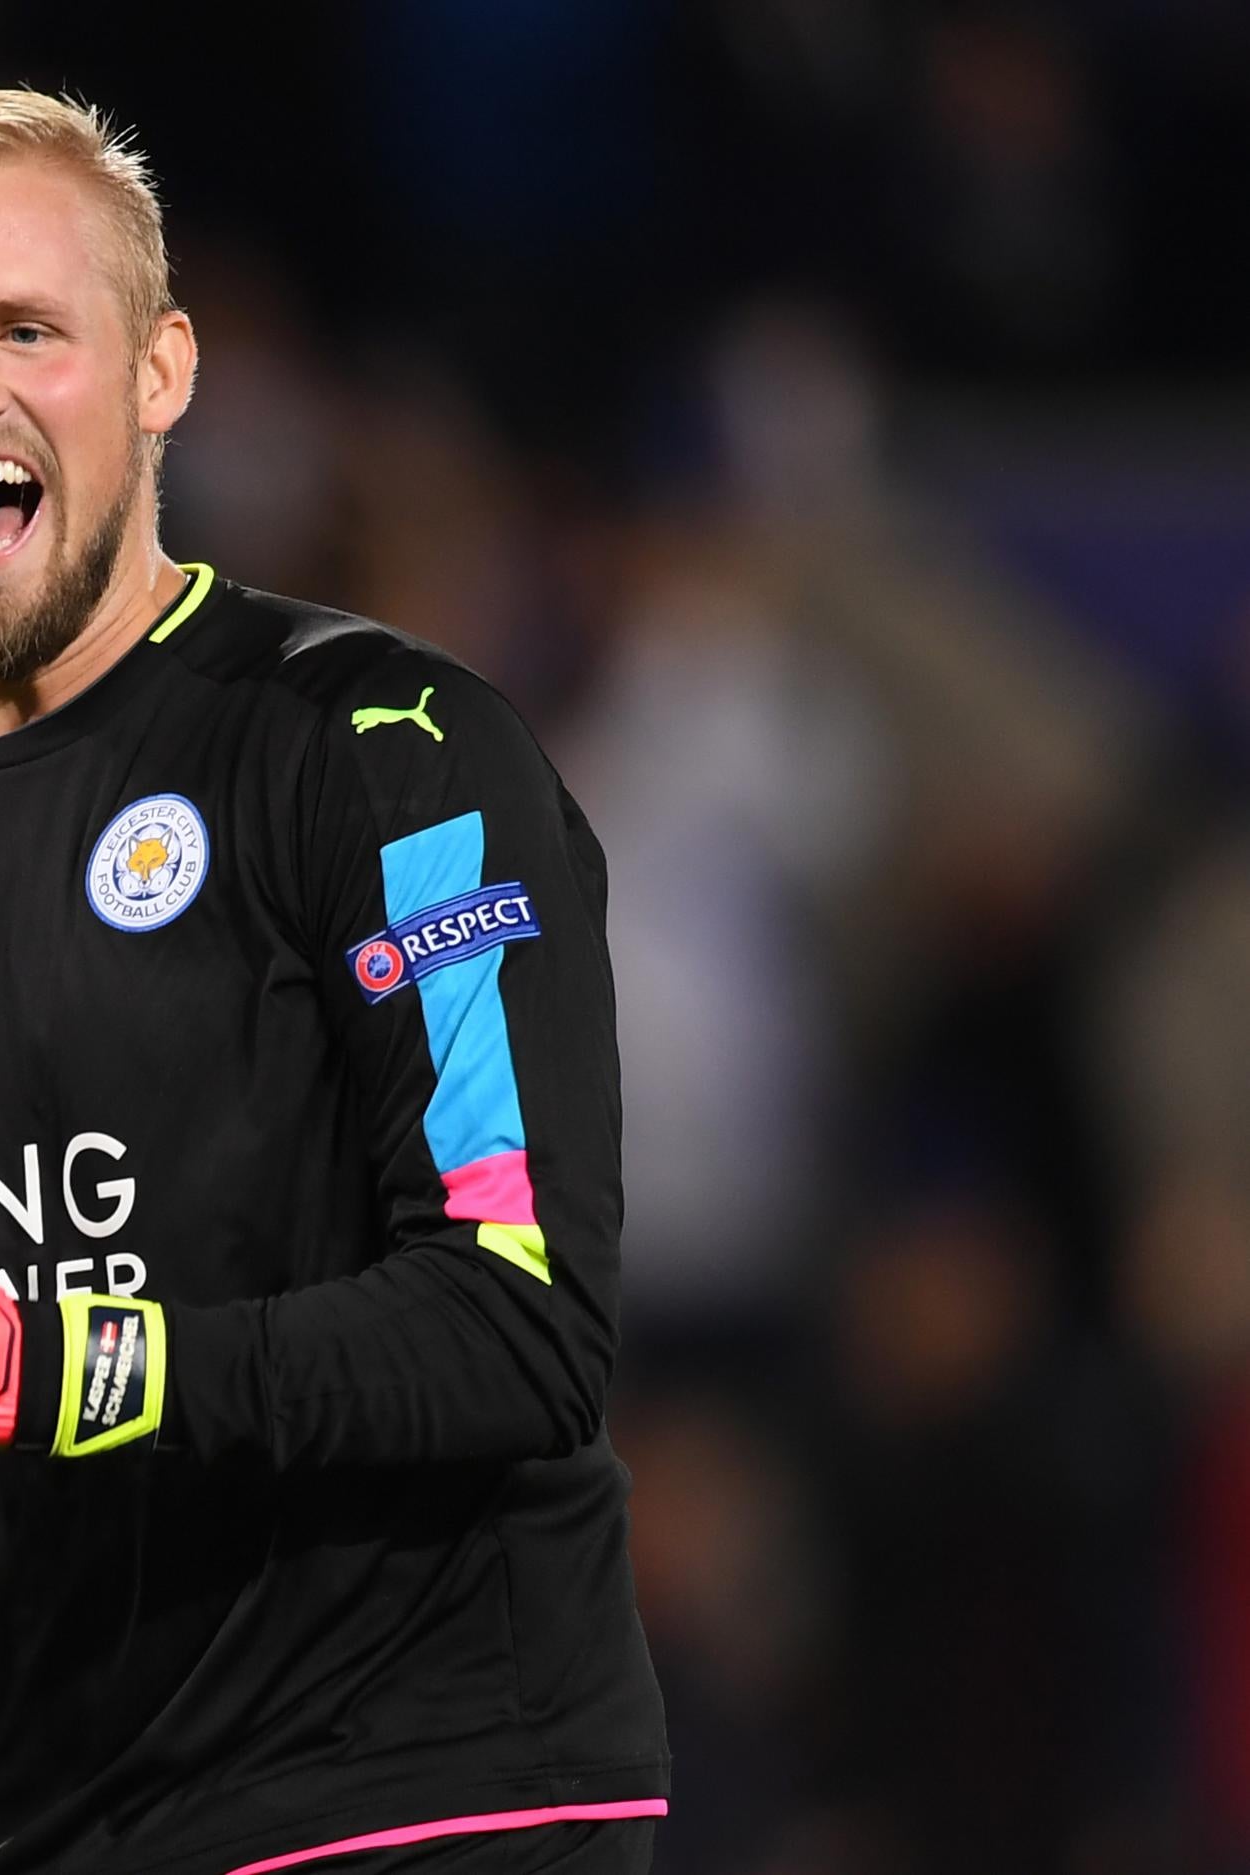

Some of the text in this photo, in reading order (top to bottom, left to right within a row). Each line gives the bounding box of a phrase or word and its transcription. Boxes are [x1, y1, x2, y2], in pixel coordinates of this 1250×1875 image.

[101, 806, 199, 862] LEICESTER CITY
[97, 860, 197, 919] FOOTBALL CLUB
[401, 896, 532, 963] RESPECT
[82, 1354, 113, 1422] KASPER
[101, 1314, 140, 1427] SCHMEICHEL
